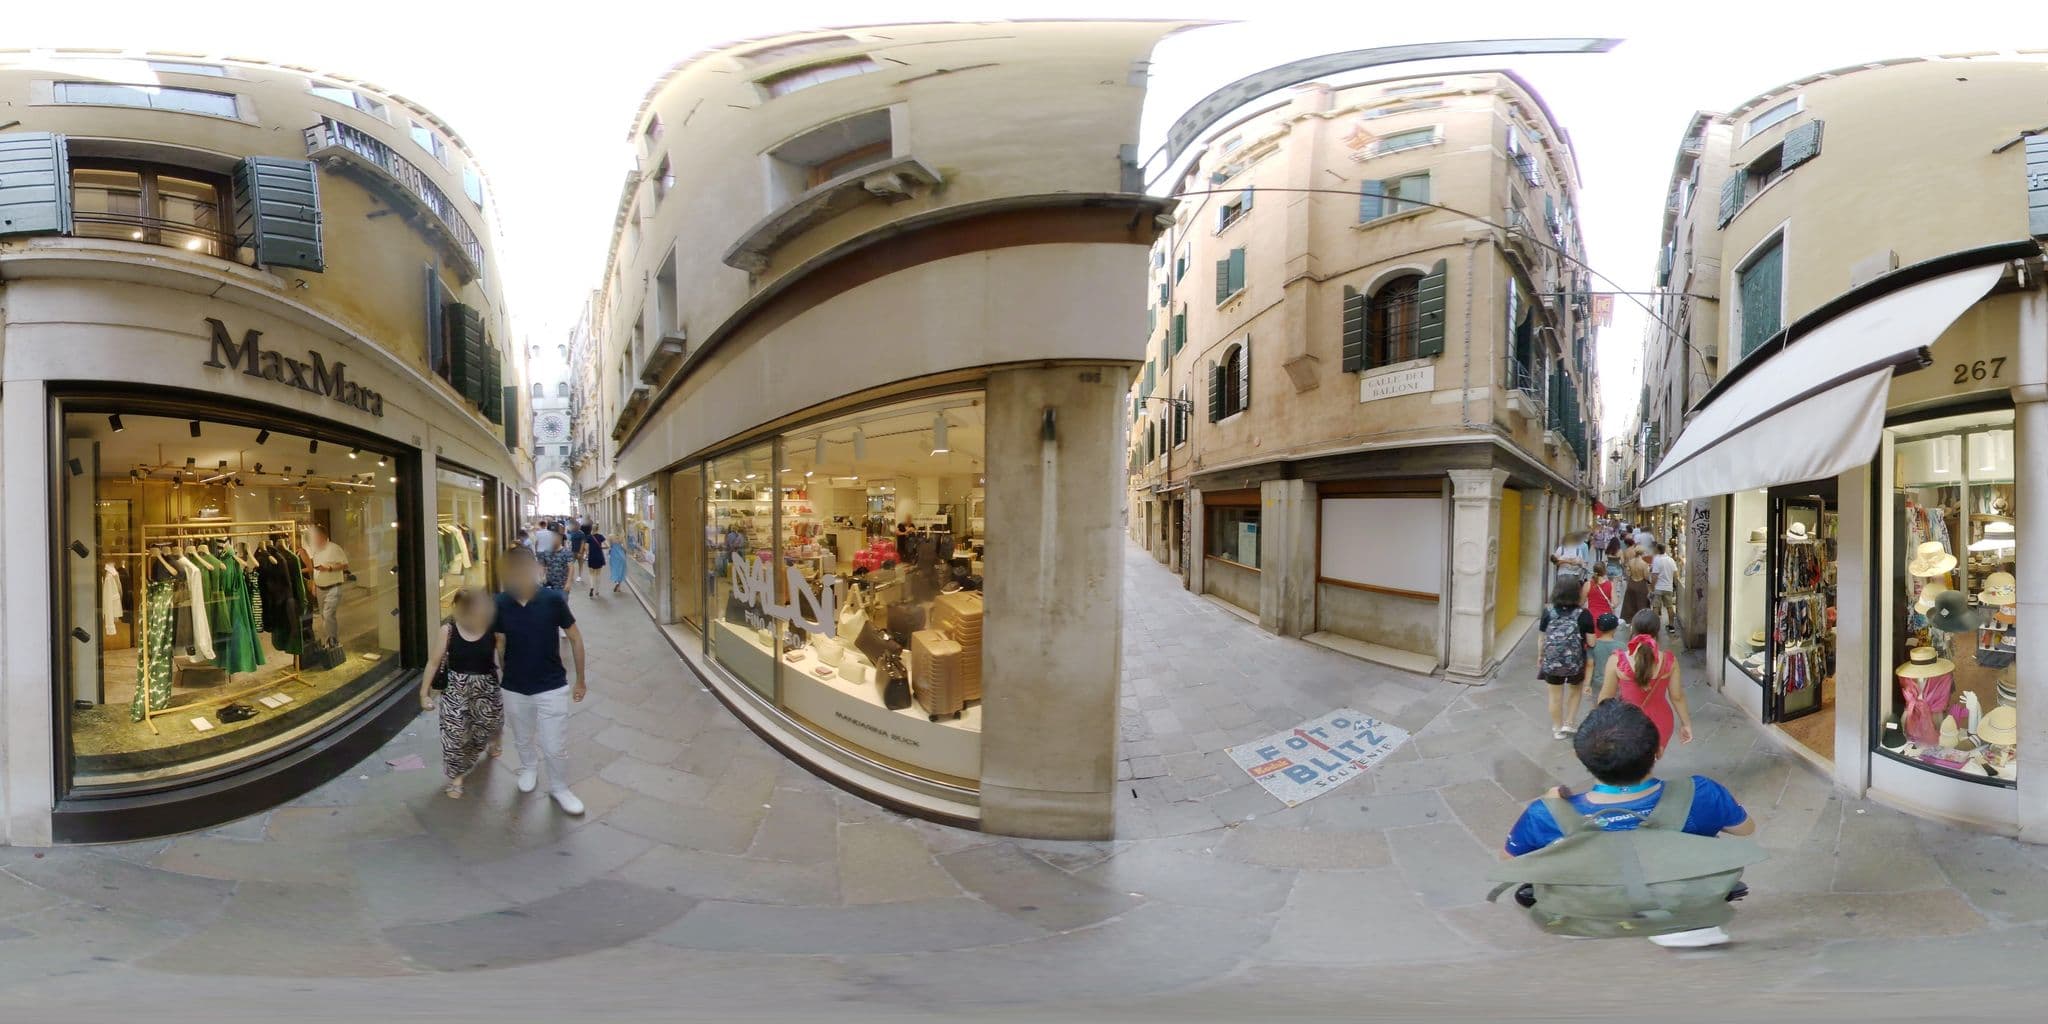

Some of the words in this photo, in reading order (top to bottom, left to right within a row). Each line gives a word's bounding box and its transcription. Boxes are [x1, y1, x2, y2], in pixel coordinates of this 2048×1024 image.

[203, 316, 385, 418] MaxMara
[1368, 375, 1400, 388] CALLE
[1953, 356, 2008, 385] 267
[1256, 717, 1351, 761] FOTO
[1282, 729, 1388, 785] BLITZ
